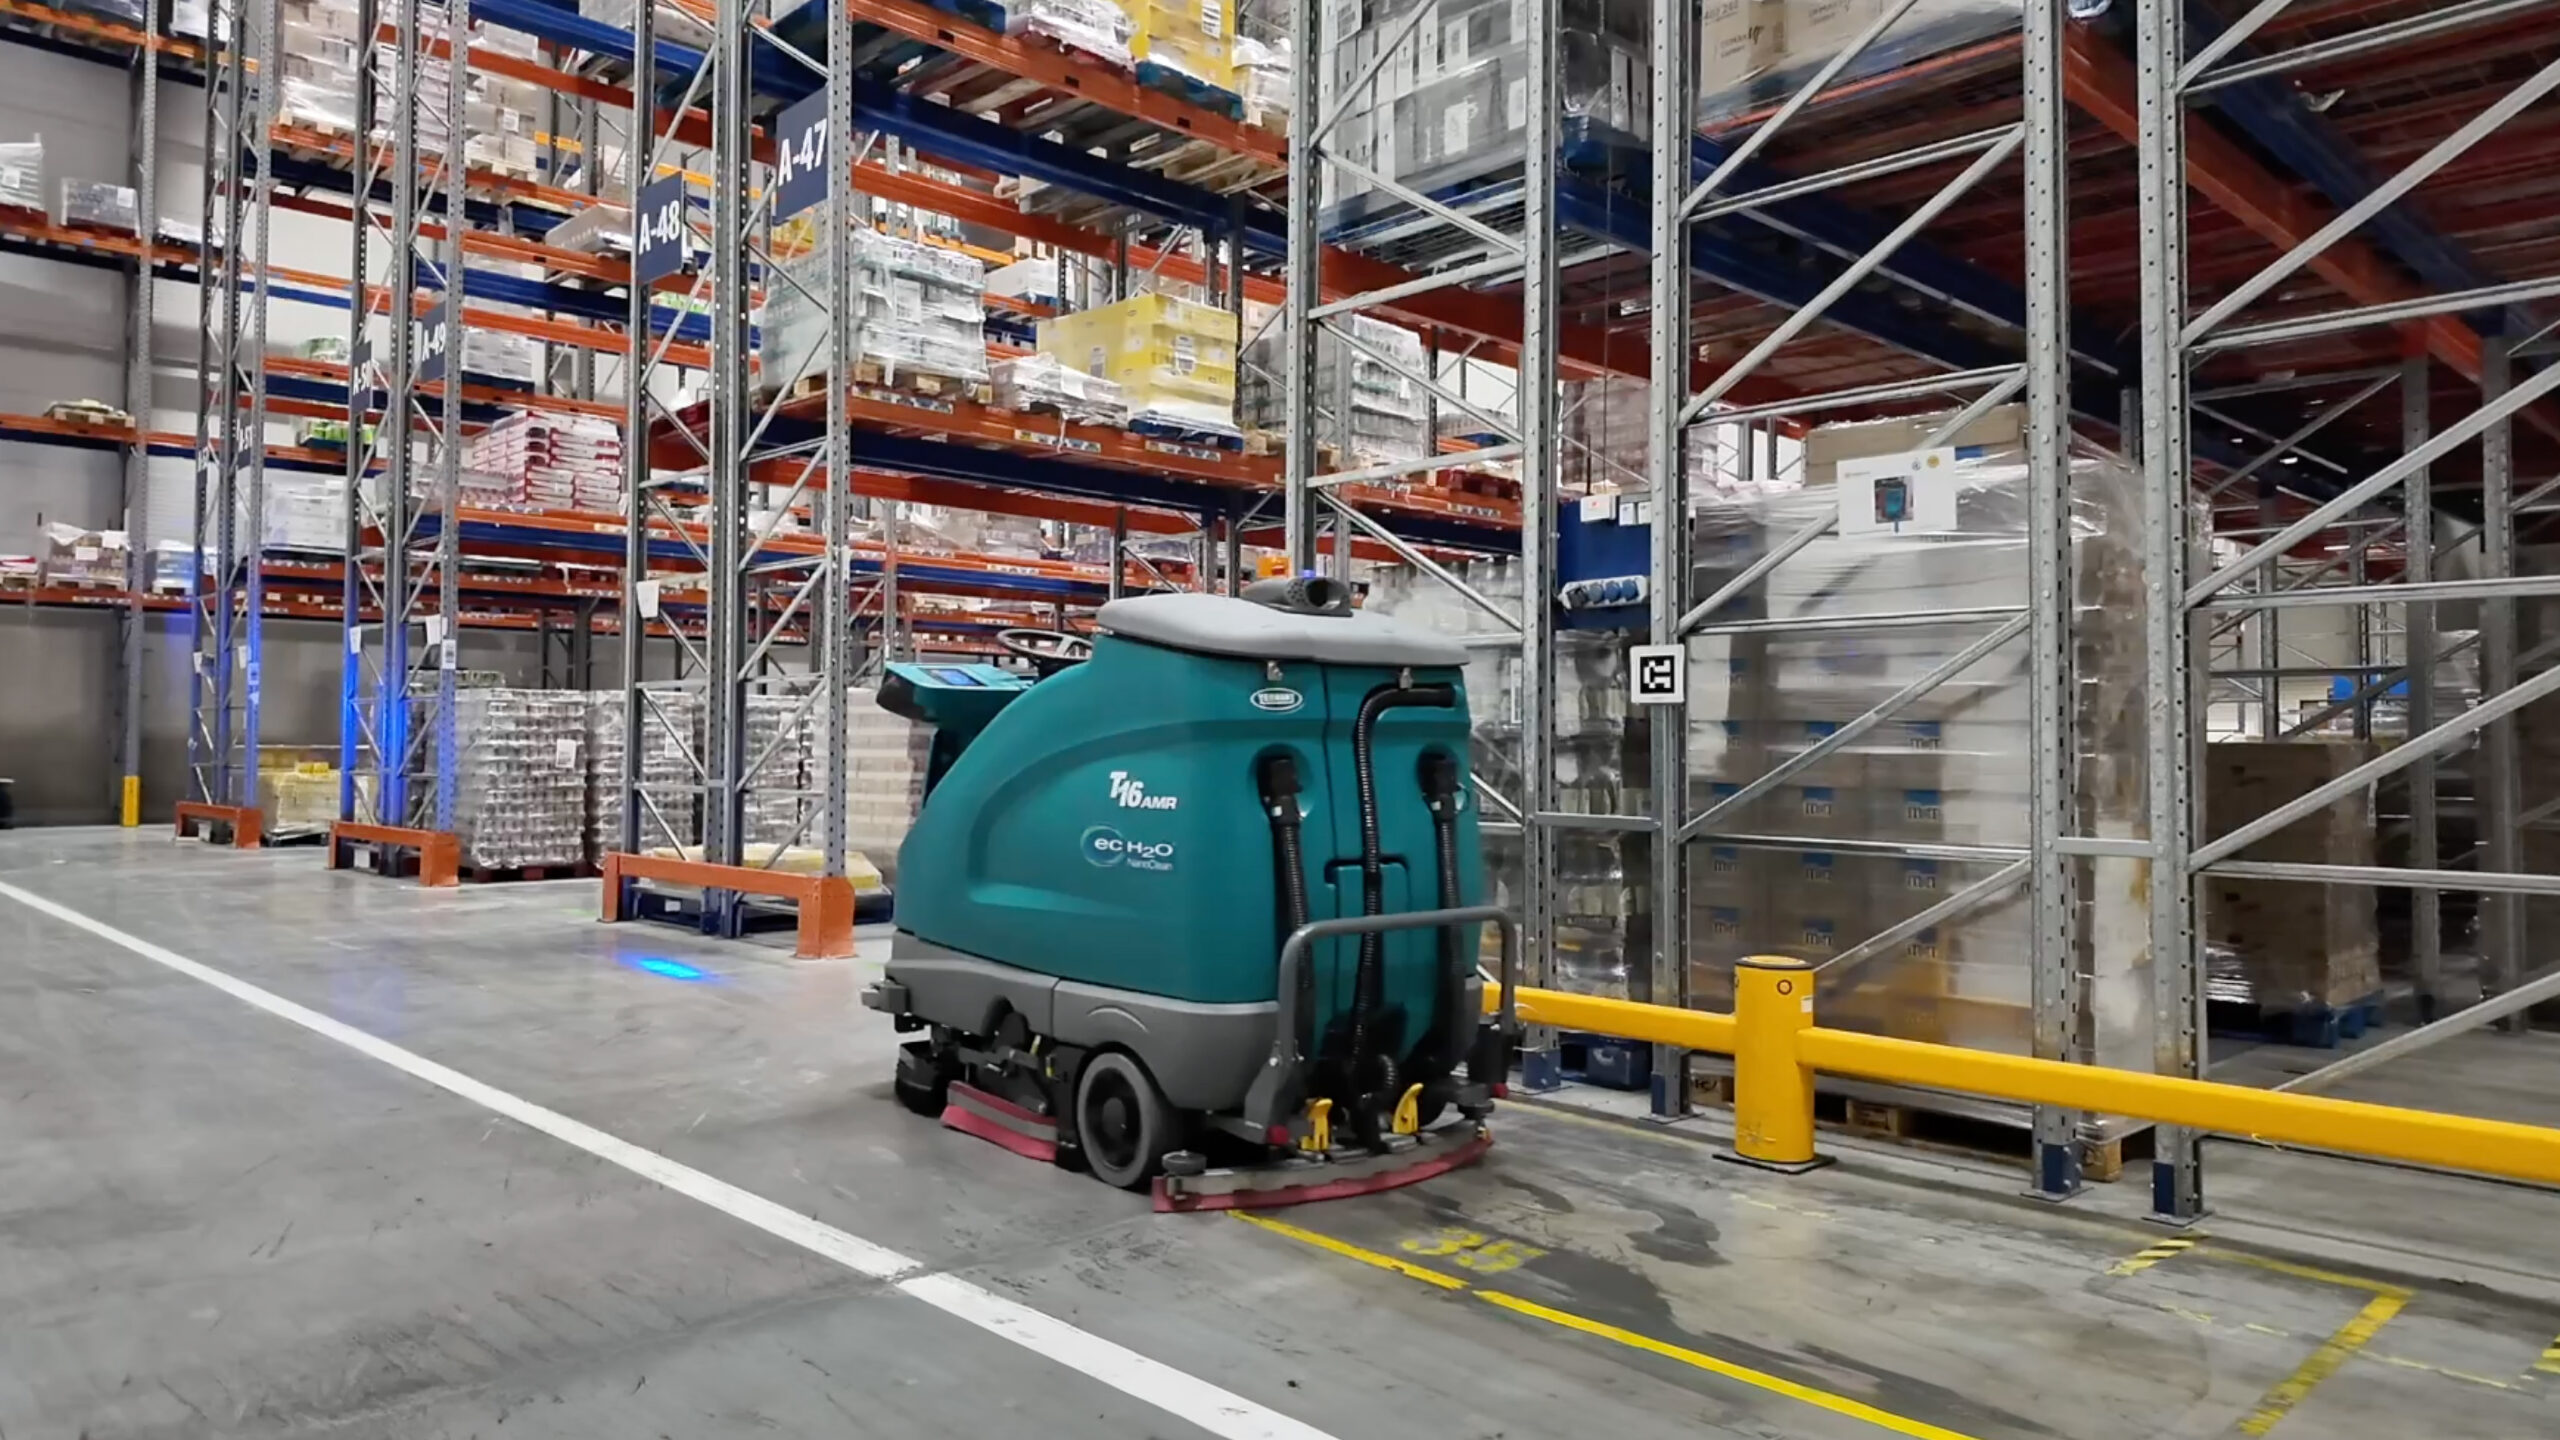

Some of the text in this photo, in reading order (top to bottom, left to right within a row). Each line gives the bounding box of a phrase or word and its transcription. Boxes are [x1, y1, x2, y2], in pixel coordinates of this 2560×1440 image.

[778, 118, 827, 186] A-47
[639, 200, 680, 254] A-48
[422, 321, 446, 362] A-49
[1109, 771, 1177, 810] T16 AMR
